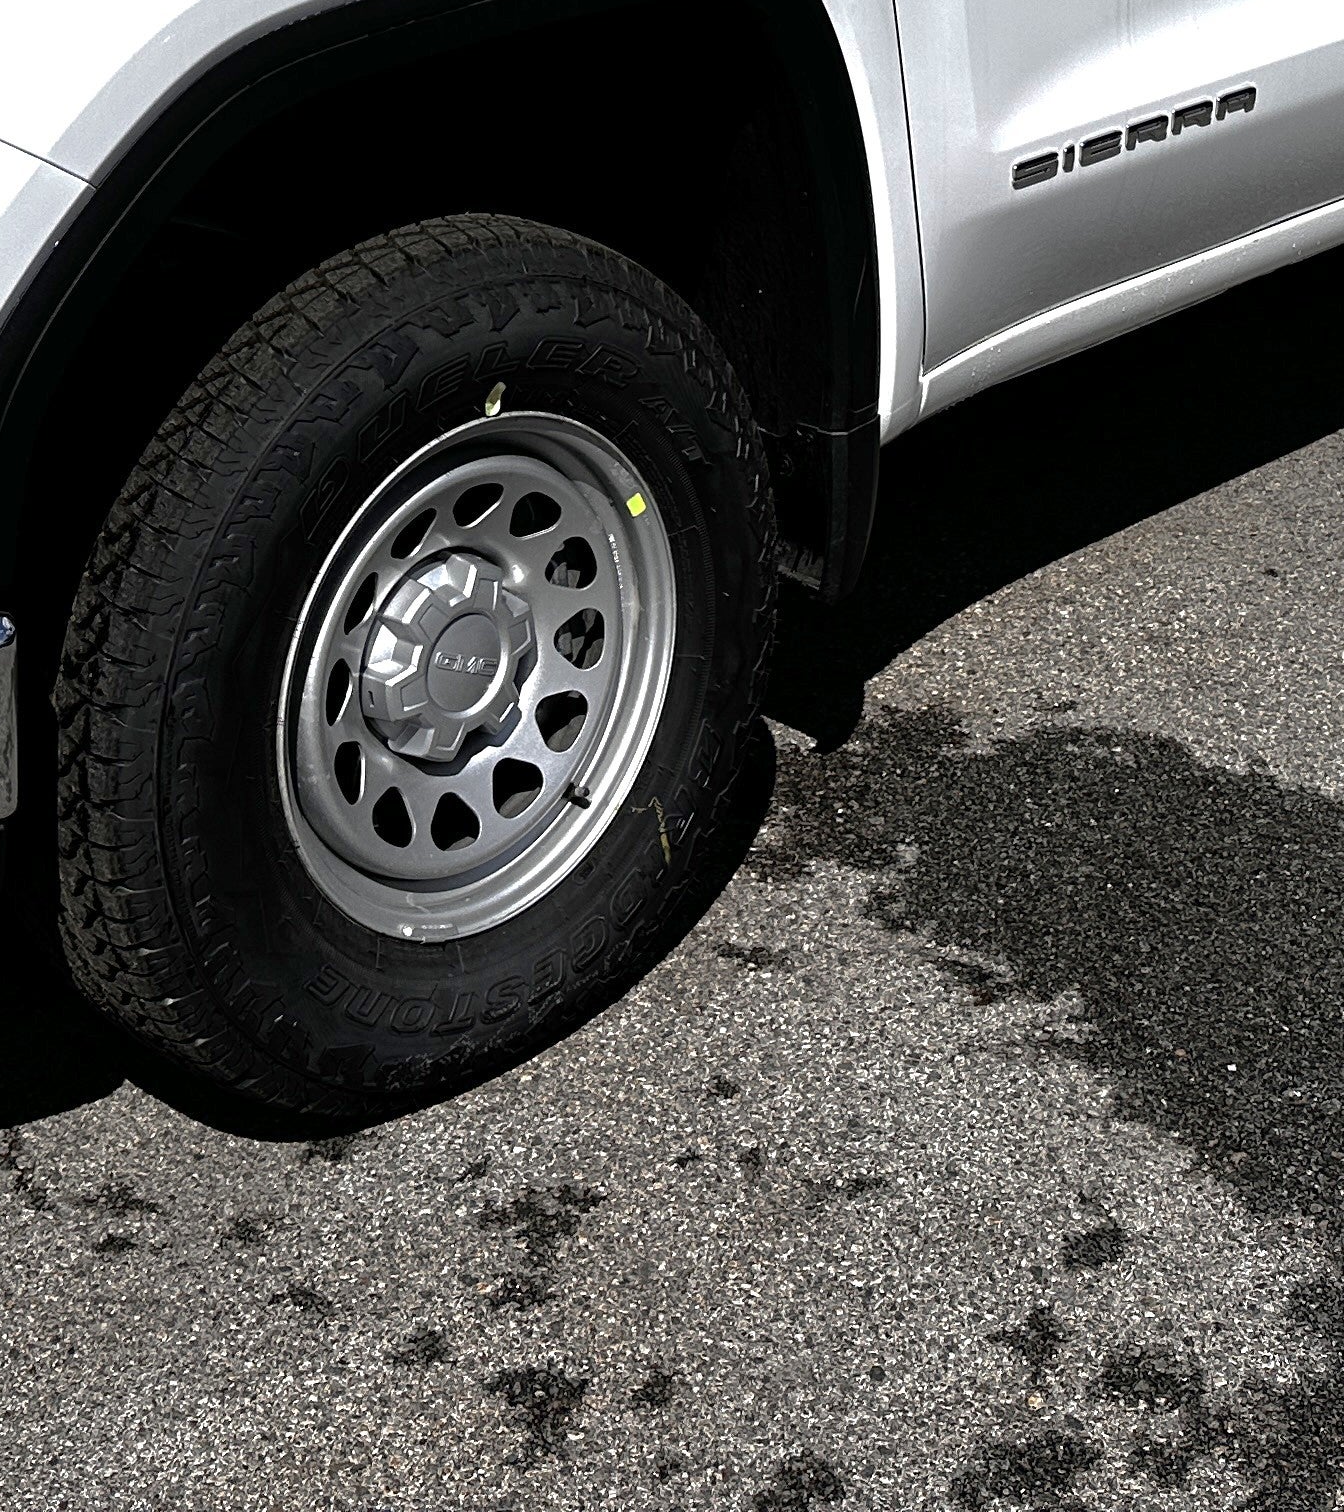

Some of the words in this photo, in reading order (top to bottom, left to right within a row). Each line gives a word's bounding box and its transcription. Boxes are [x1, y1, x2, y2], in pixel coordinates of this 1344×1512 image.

[1011, 83, 1258, 190] SIERRA
[297, 334, 643, 541] DUELER
[434, 651, 499, 677] GMC
